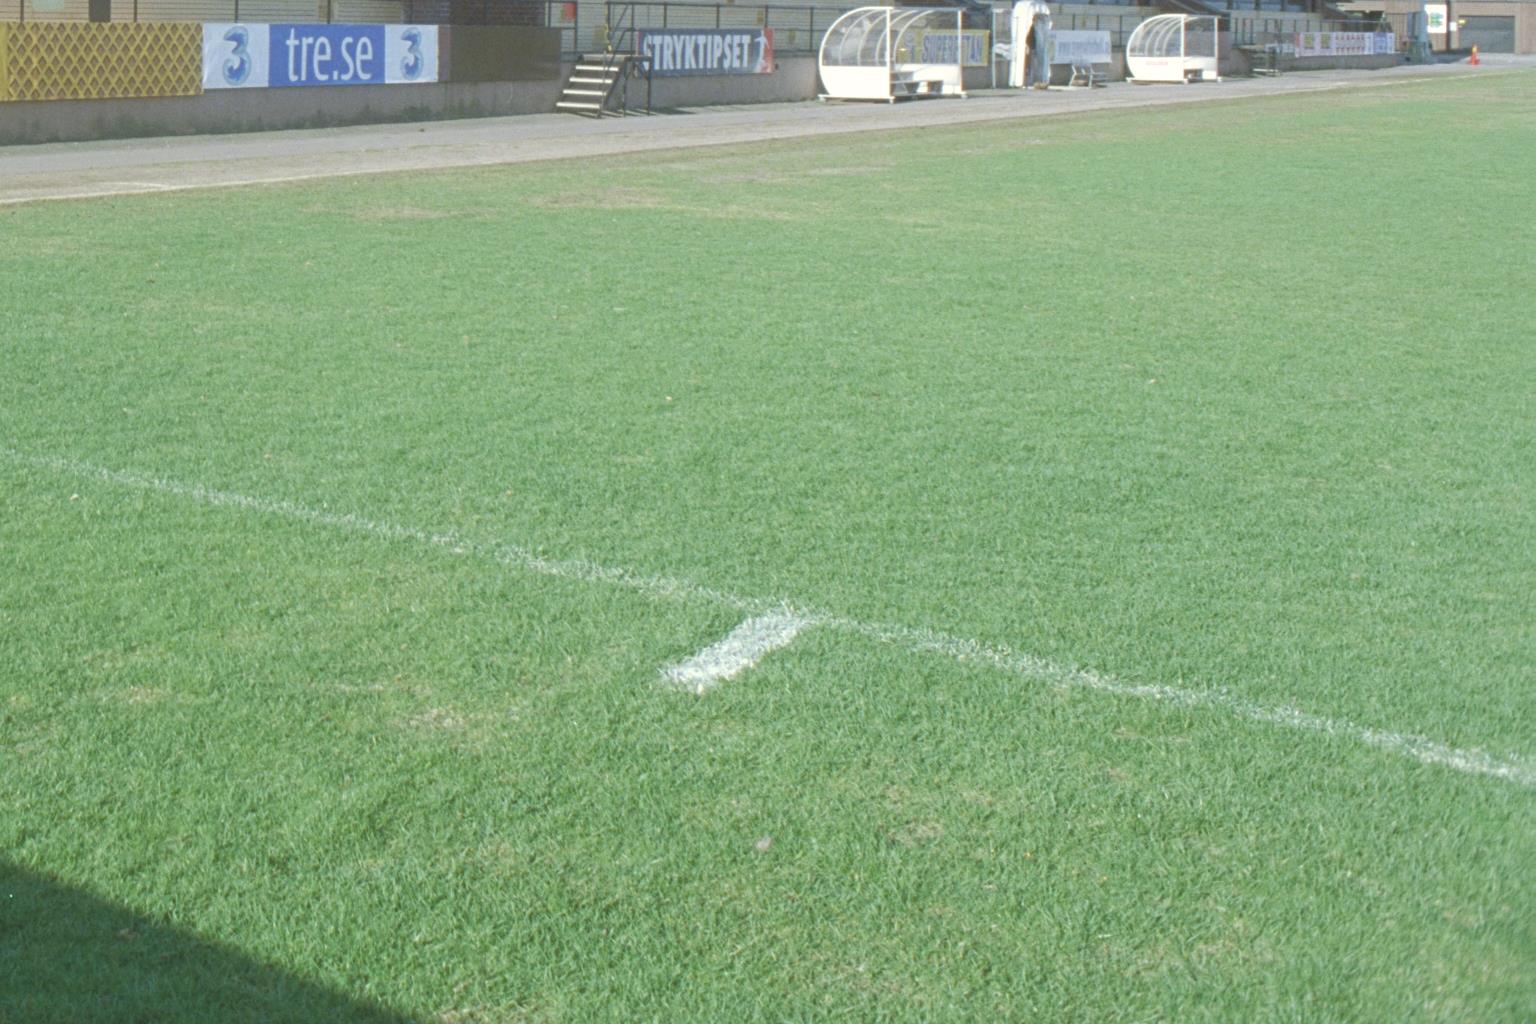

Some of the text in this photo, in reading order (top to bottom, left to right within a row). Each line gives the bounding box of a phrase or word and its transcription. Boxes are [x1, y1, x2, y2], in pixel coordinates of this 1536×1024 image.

[223, 26, 252, 86] 3
[286, 28, 373, 81] tre.se
[400, 26, 424, 80] 3
[642, 33, 751, 72] STRYKTIPSET
